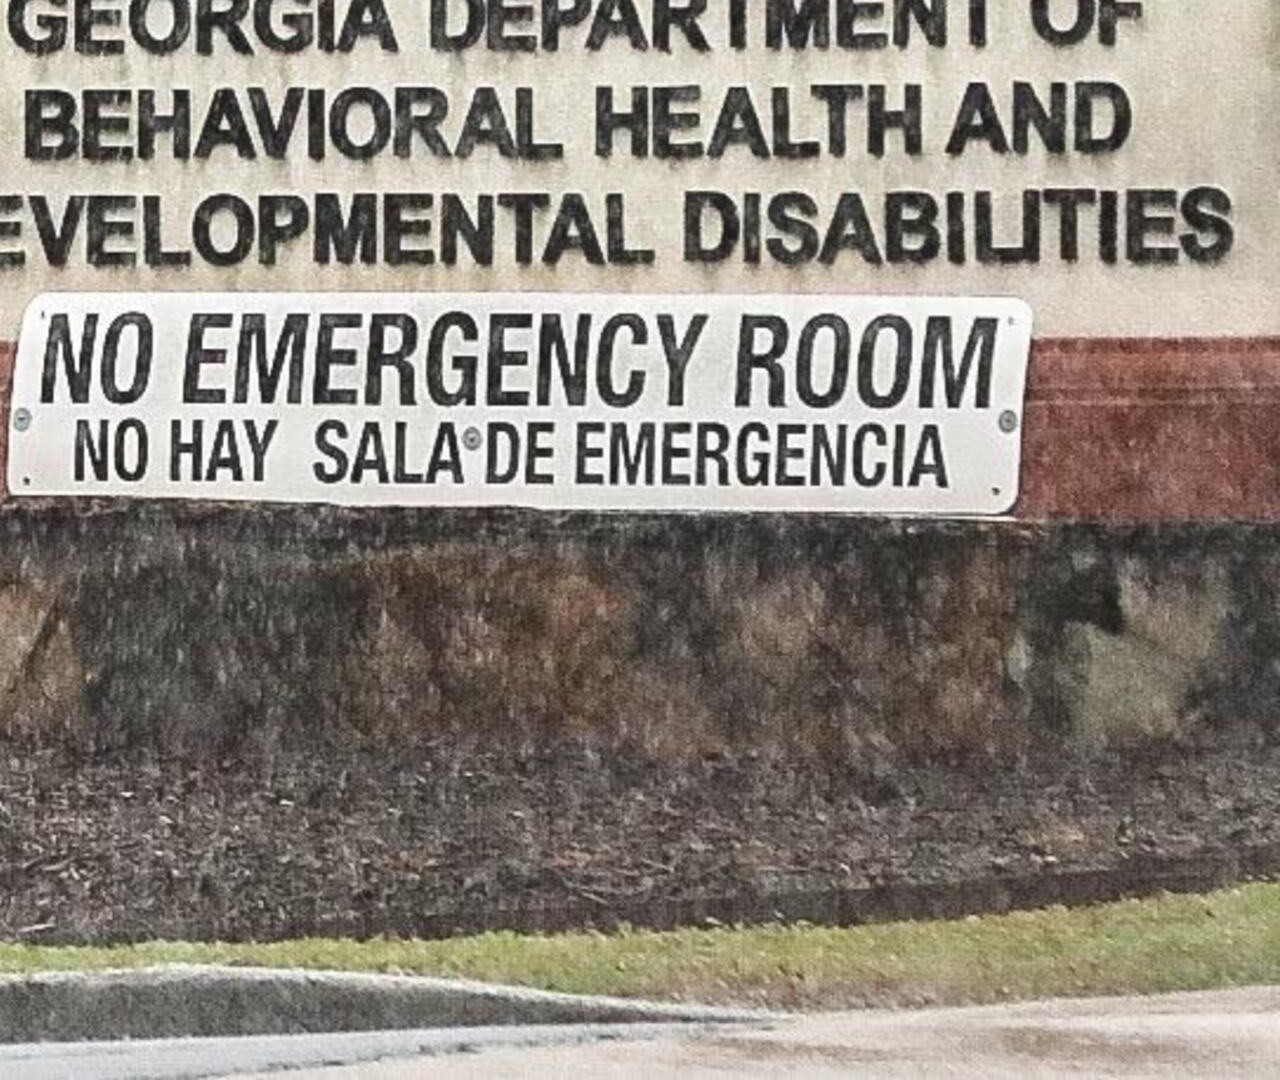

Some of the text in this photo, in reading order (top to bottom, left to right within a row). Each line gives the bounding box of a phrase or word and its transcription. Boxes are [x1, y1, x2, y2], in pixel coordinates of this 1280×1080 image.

[23, 80, 1132, 162] BEHAVIORAL HEALTH AND
[682, 185, 1235, 266] DISABILITIES
[39, 310, 999, 411] NO EMERGENCY ROOM
[73, 418, 949, 489] NO HAY SALA DE EMERGENCIA
